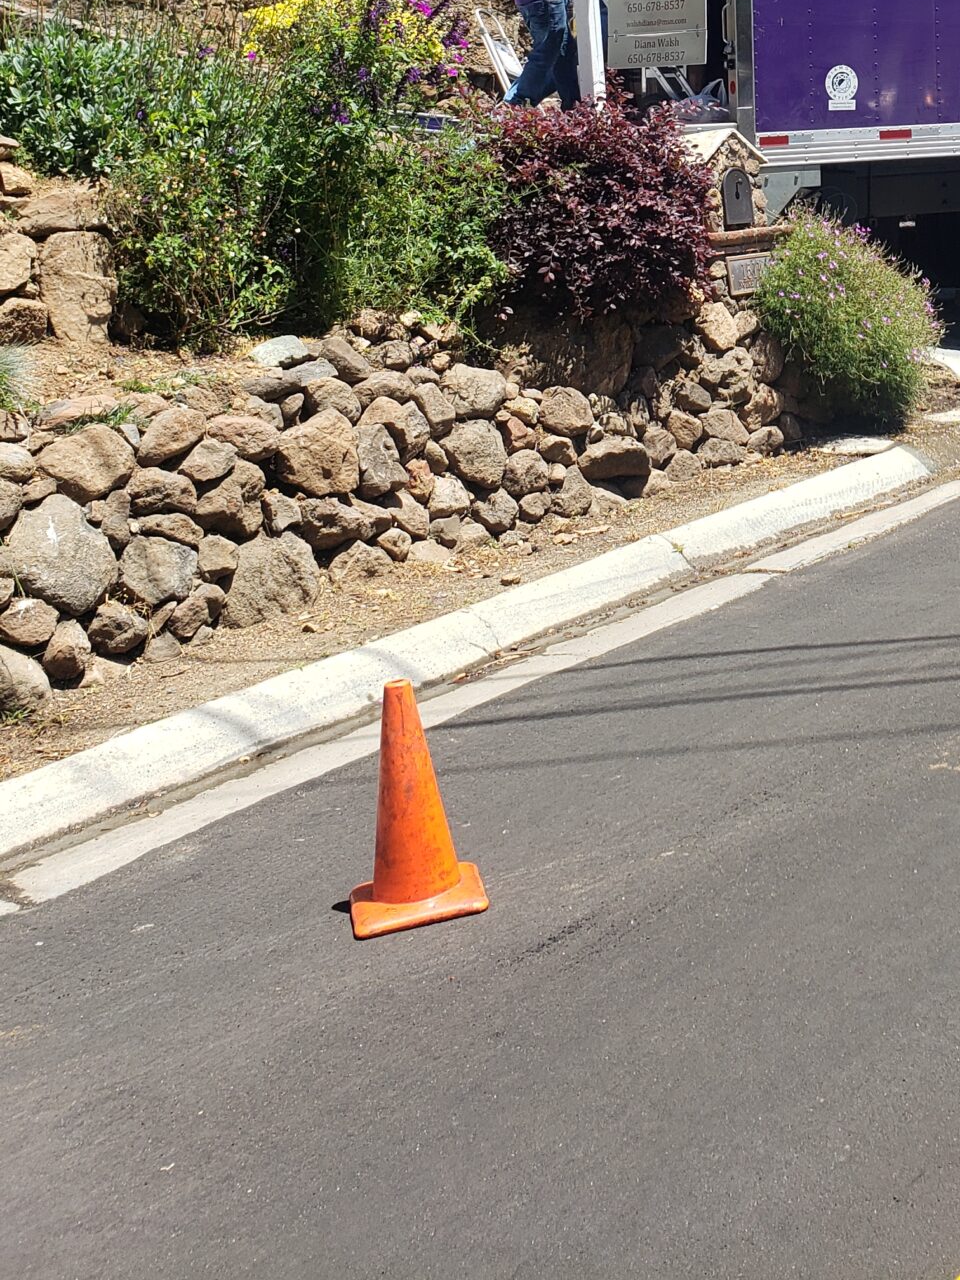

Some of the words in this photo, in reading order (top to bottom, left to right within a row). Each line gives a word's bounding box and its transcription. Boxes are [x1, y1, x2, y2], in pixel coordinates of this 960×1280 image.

[627, 0, 686, 13] 650-678-8537
[634, 39, 656, 49] Diana
[657, 37, 680, 48] Walsh
[627, 51, 686, 64] 650-678-8537
